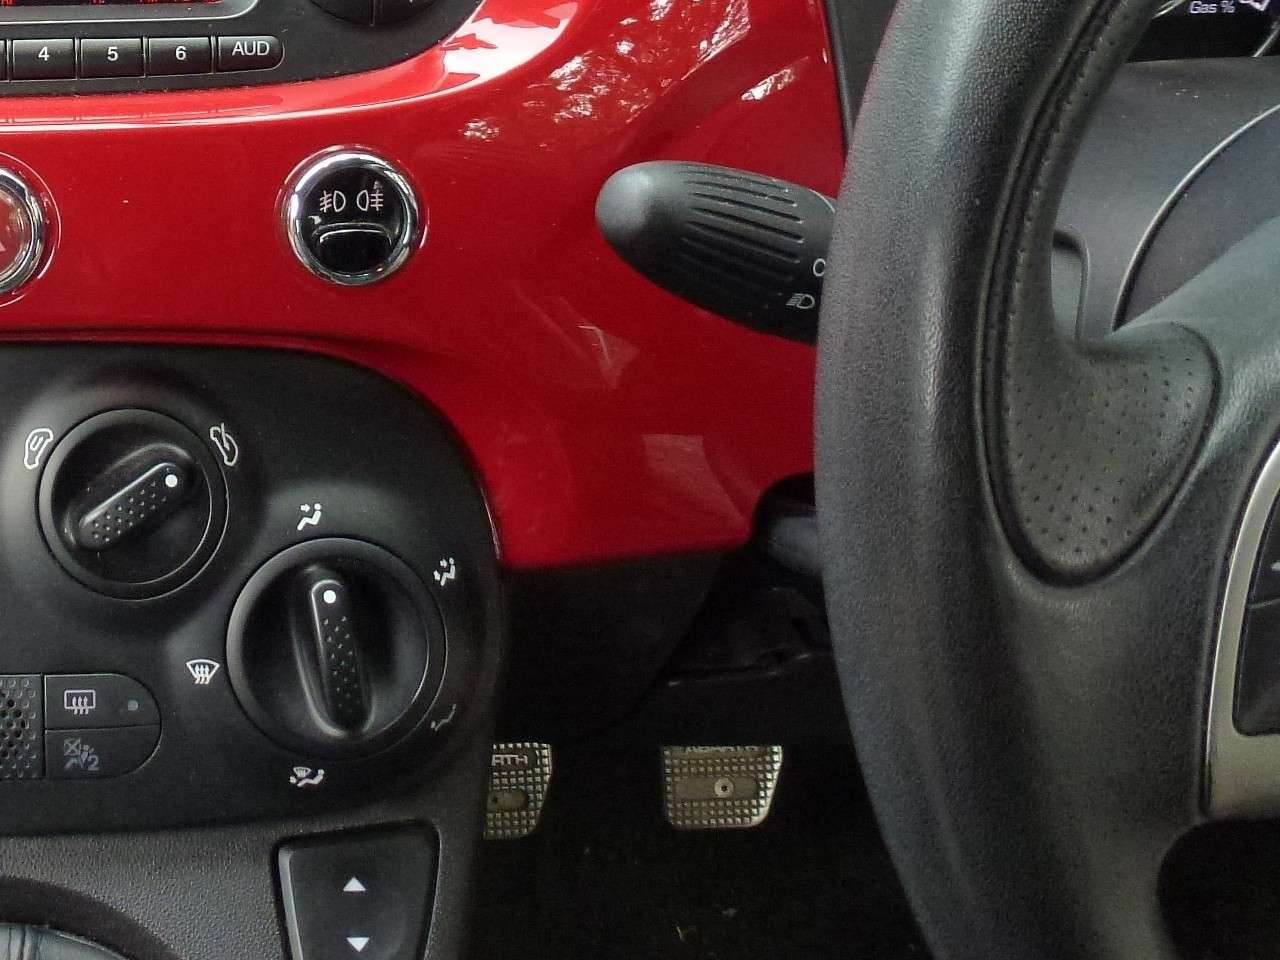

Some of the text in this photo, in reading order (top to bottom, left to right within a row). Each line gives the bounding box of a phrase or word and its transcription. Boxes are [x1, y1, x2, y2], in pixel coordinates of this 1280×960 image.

[1189, 0, 1218, 14] Gas
[37, 46, 50, 61] 4
[106, 46, 119, 61] 5
[174, 45, 187, 61] 6
[231, 40, 270, 57] AUD
